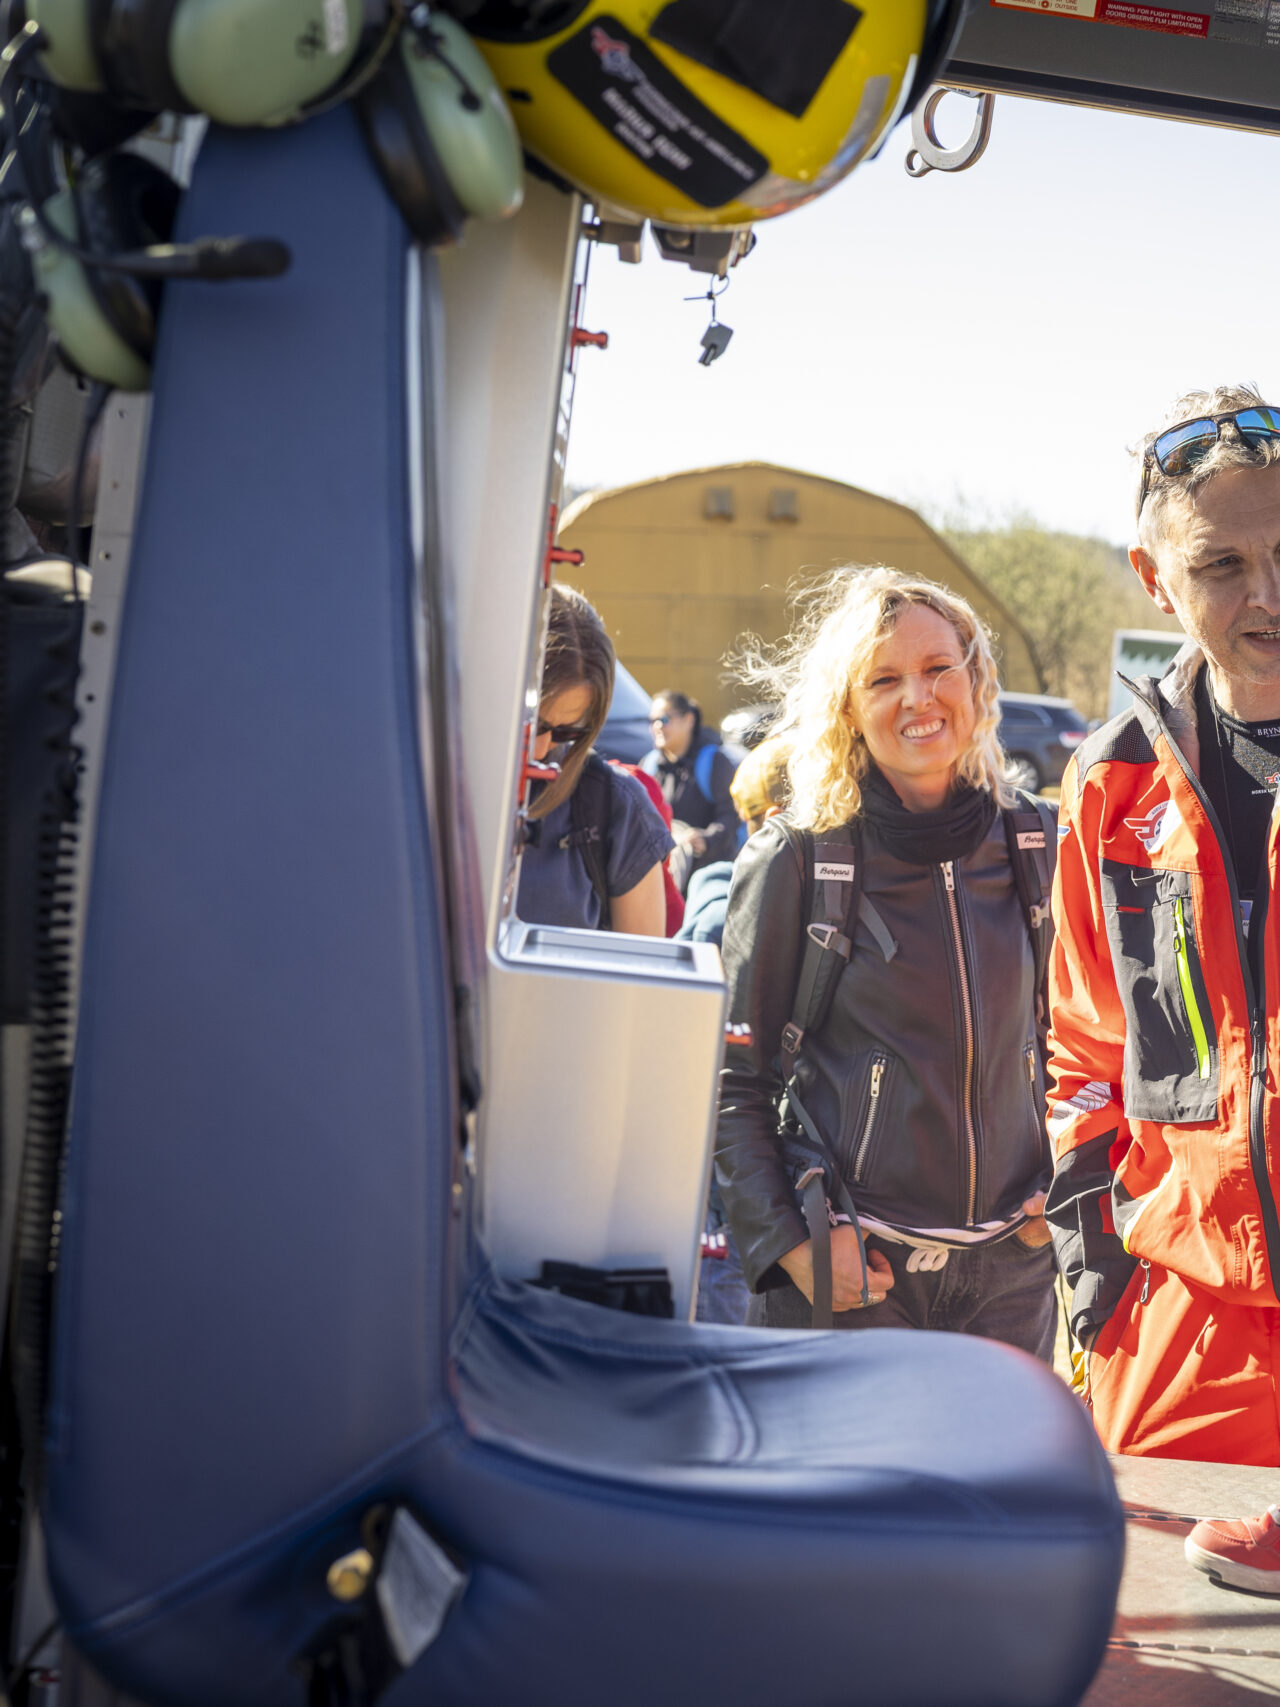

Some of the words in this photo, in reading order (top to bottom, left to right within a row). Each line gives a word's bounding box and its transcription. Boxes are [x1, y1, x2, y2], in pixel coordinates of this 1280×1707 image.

[1054, 3, 1079, 11] OUTSIDE
[1105, 10, 1126, 18] DOORS
[1126, 13, 1155, 23] OBSERVE
[1167, 18, 1203, 30] LIMITATIONS
[1150, 9, 1170, 18] FLIGHT
[1170, 13, 1187, 21] WITH
[1186, 15, 1204, 23] OPEN
[820, 866, 850, 877] Bergans
